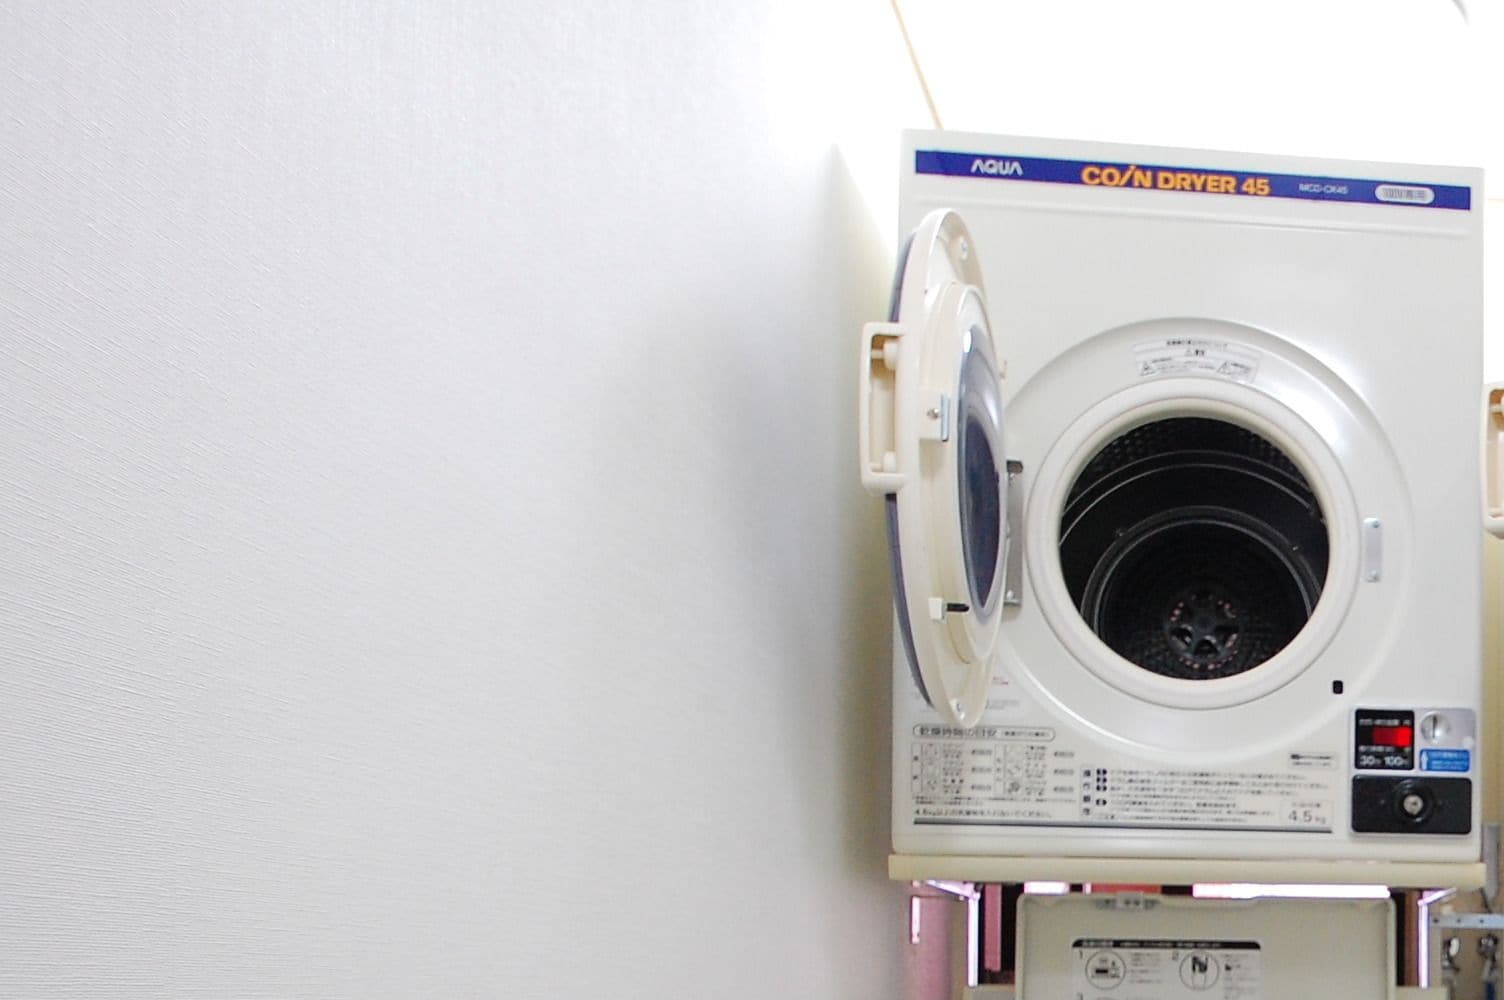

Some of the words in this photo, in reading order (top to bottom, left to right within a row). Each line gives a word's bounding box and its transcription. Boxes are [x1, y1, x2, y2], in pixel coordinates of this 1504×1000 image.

[970, 159, 1023, 177] AQUA
[1081, 164, 1152, 191] COIN
[1158, 170, 1236, 194] DRYER
[1242, 177, 1271, 196] 45
